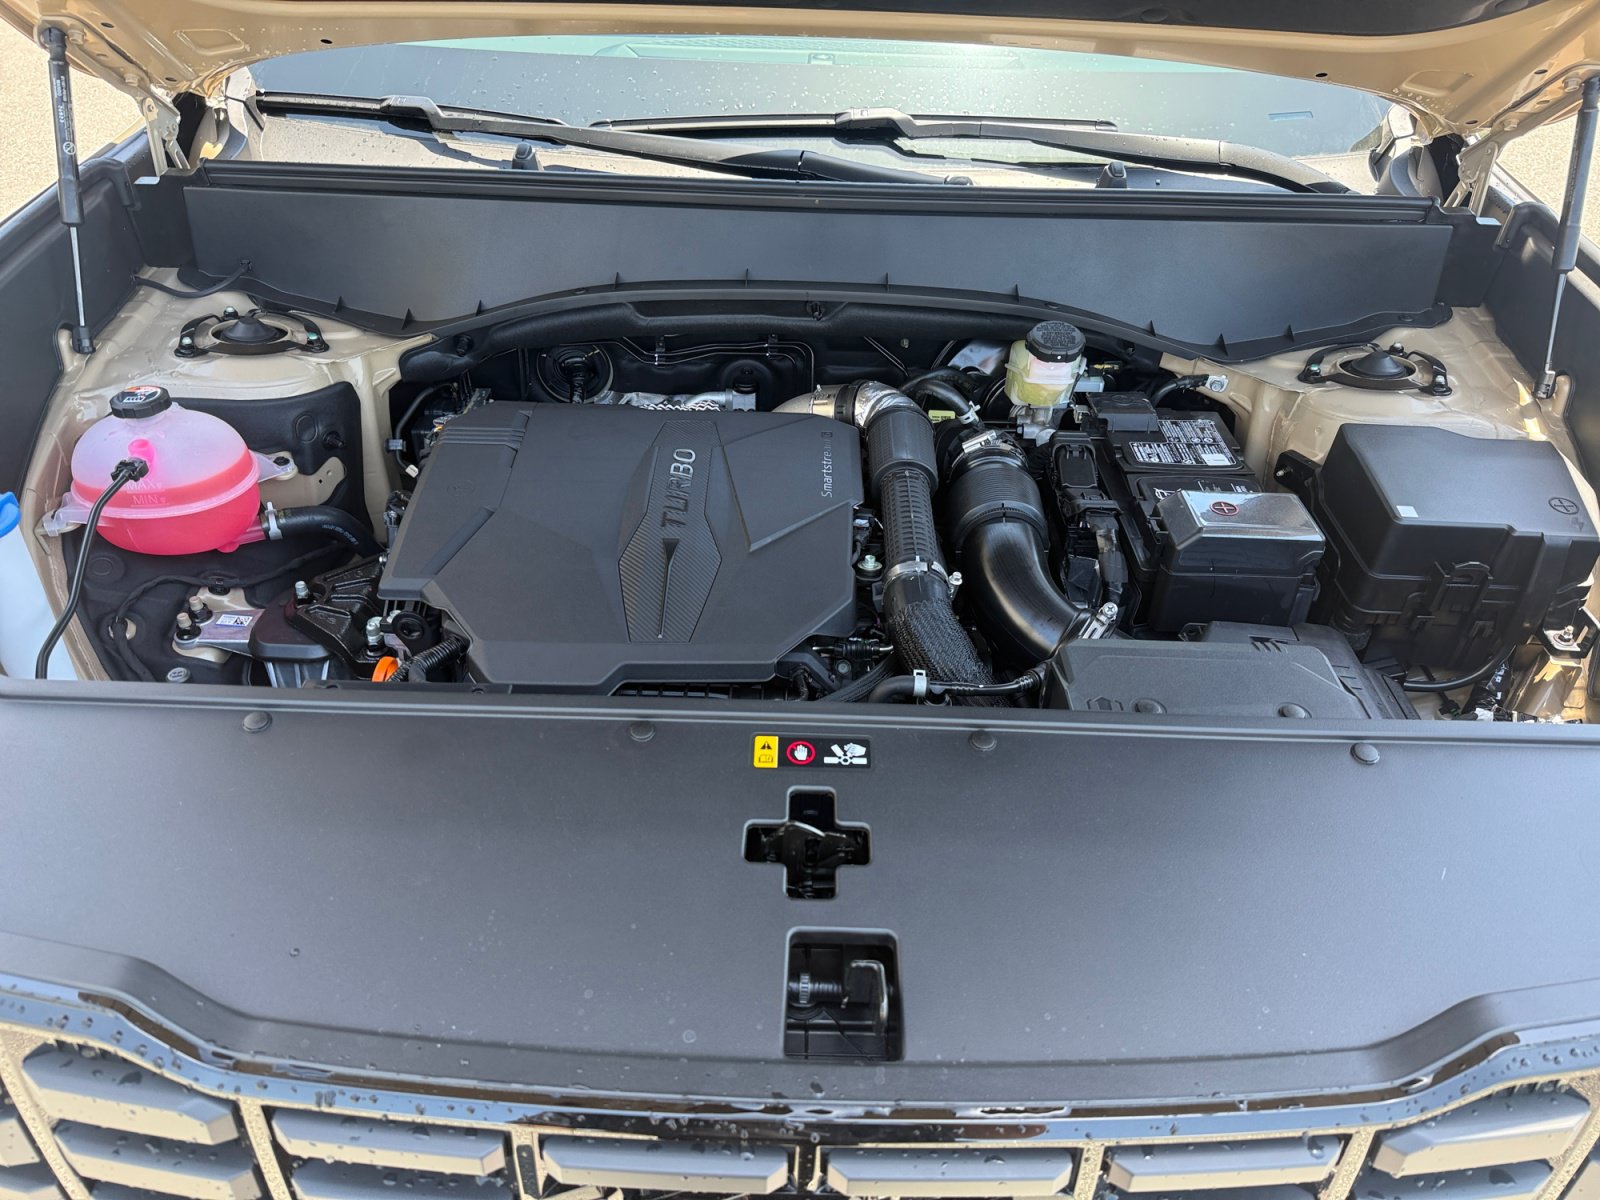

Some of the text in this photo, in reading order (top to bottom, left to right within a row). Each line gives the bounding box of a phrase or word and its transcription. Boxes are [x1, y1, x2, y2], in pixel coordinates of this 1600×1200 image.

[661, 448, 696, 527] TURBO
[821, 439, 833, 498] Smartstream
[132, 494, 159, 505] MIN
